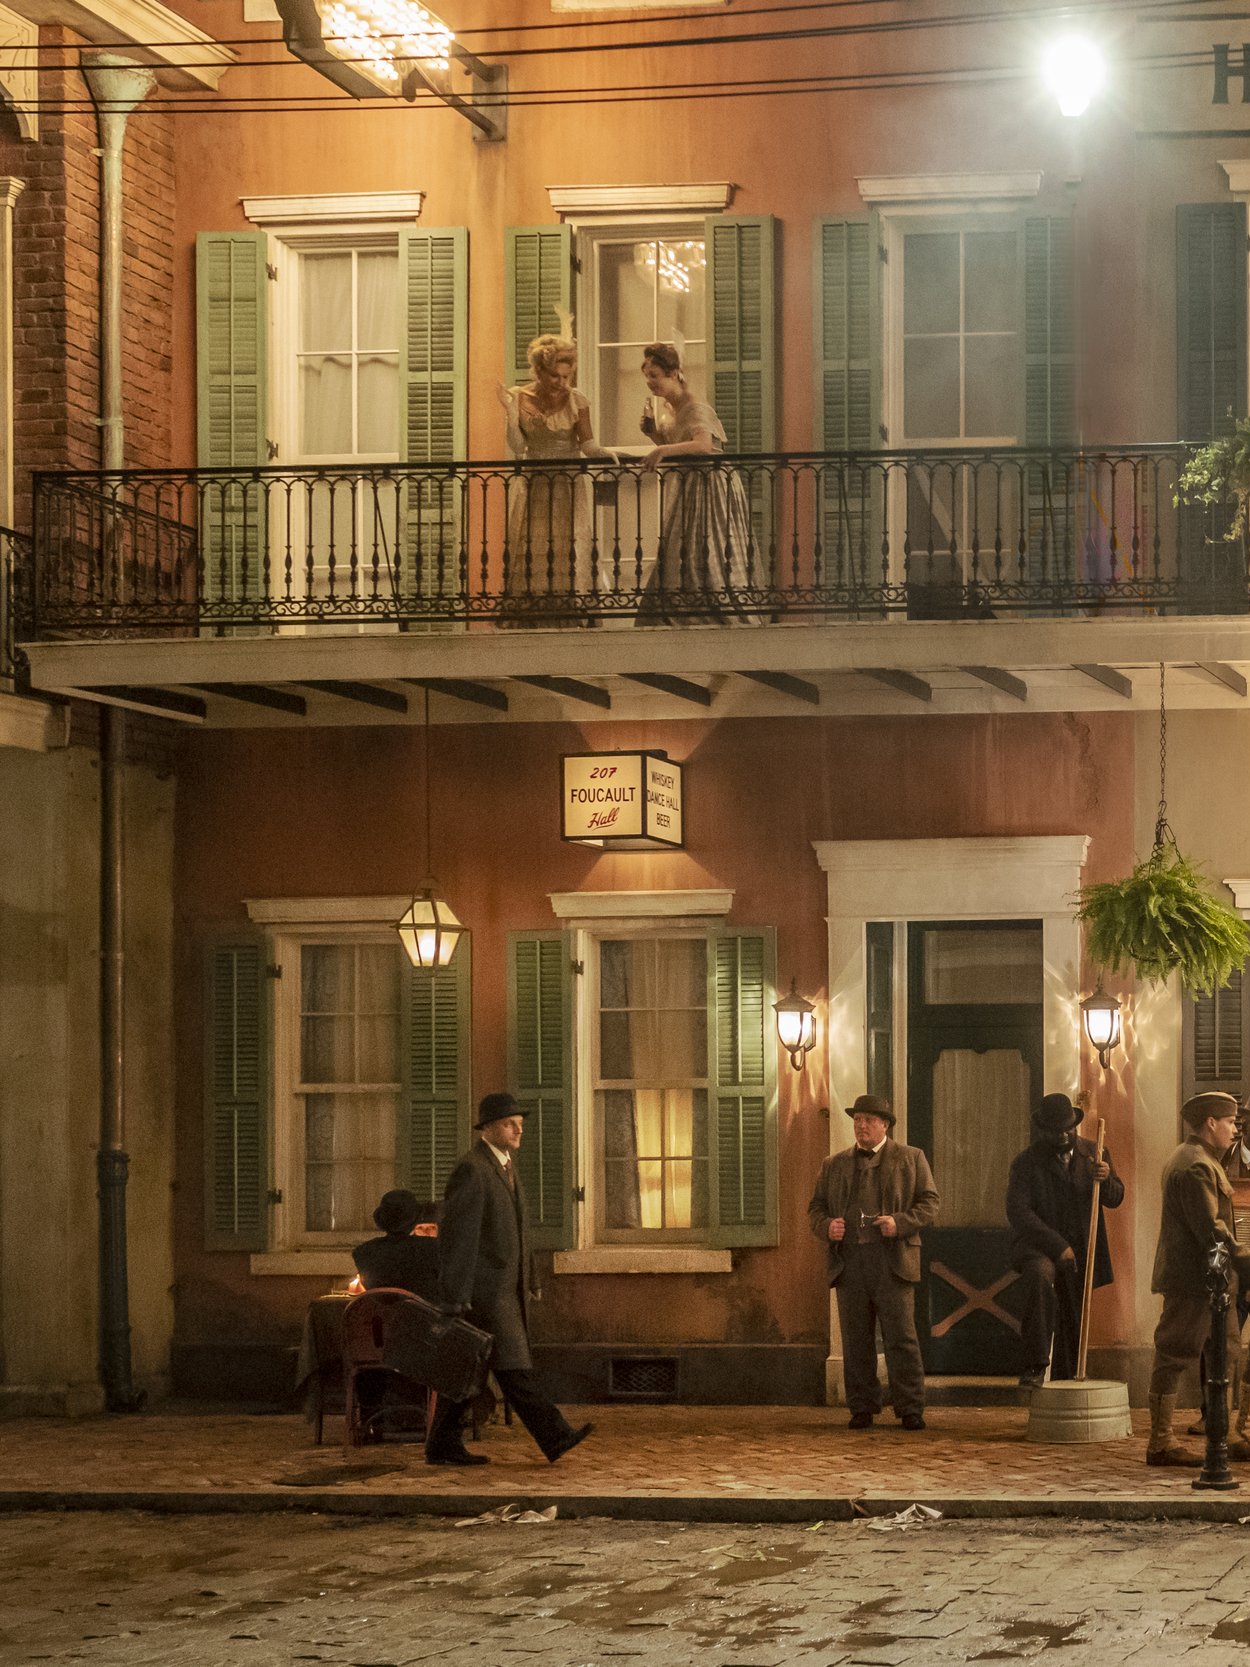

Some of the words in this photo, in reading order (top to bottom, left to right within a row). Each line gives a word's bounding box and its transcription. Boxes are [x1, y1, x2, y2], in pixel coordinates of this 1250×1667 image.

[590, 767, 617, 779] 207
[651, 771, 674, 789] WHISKEY
[571, 787, 636, 803] FOUCAULT
[647, 789, 665, 807] DANCE
[666, 796, 679, 811] HALL
[587, 807, 620, 829] Hall
[656, 812, 671, 828] BEER
